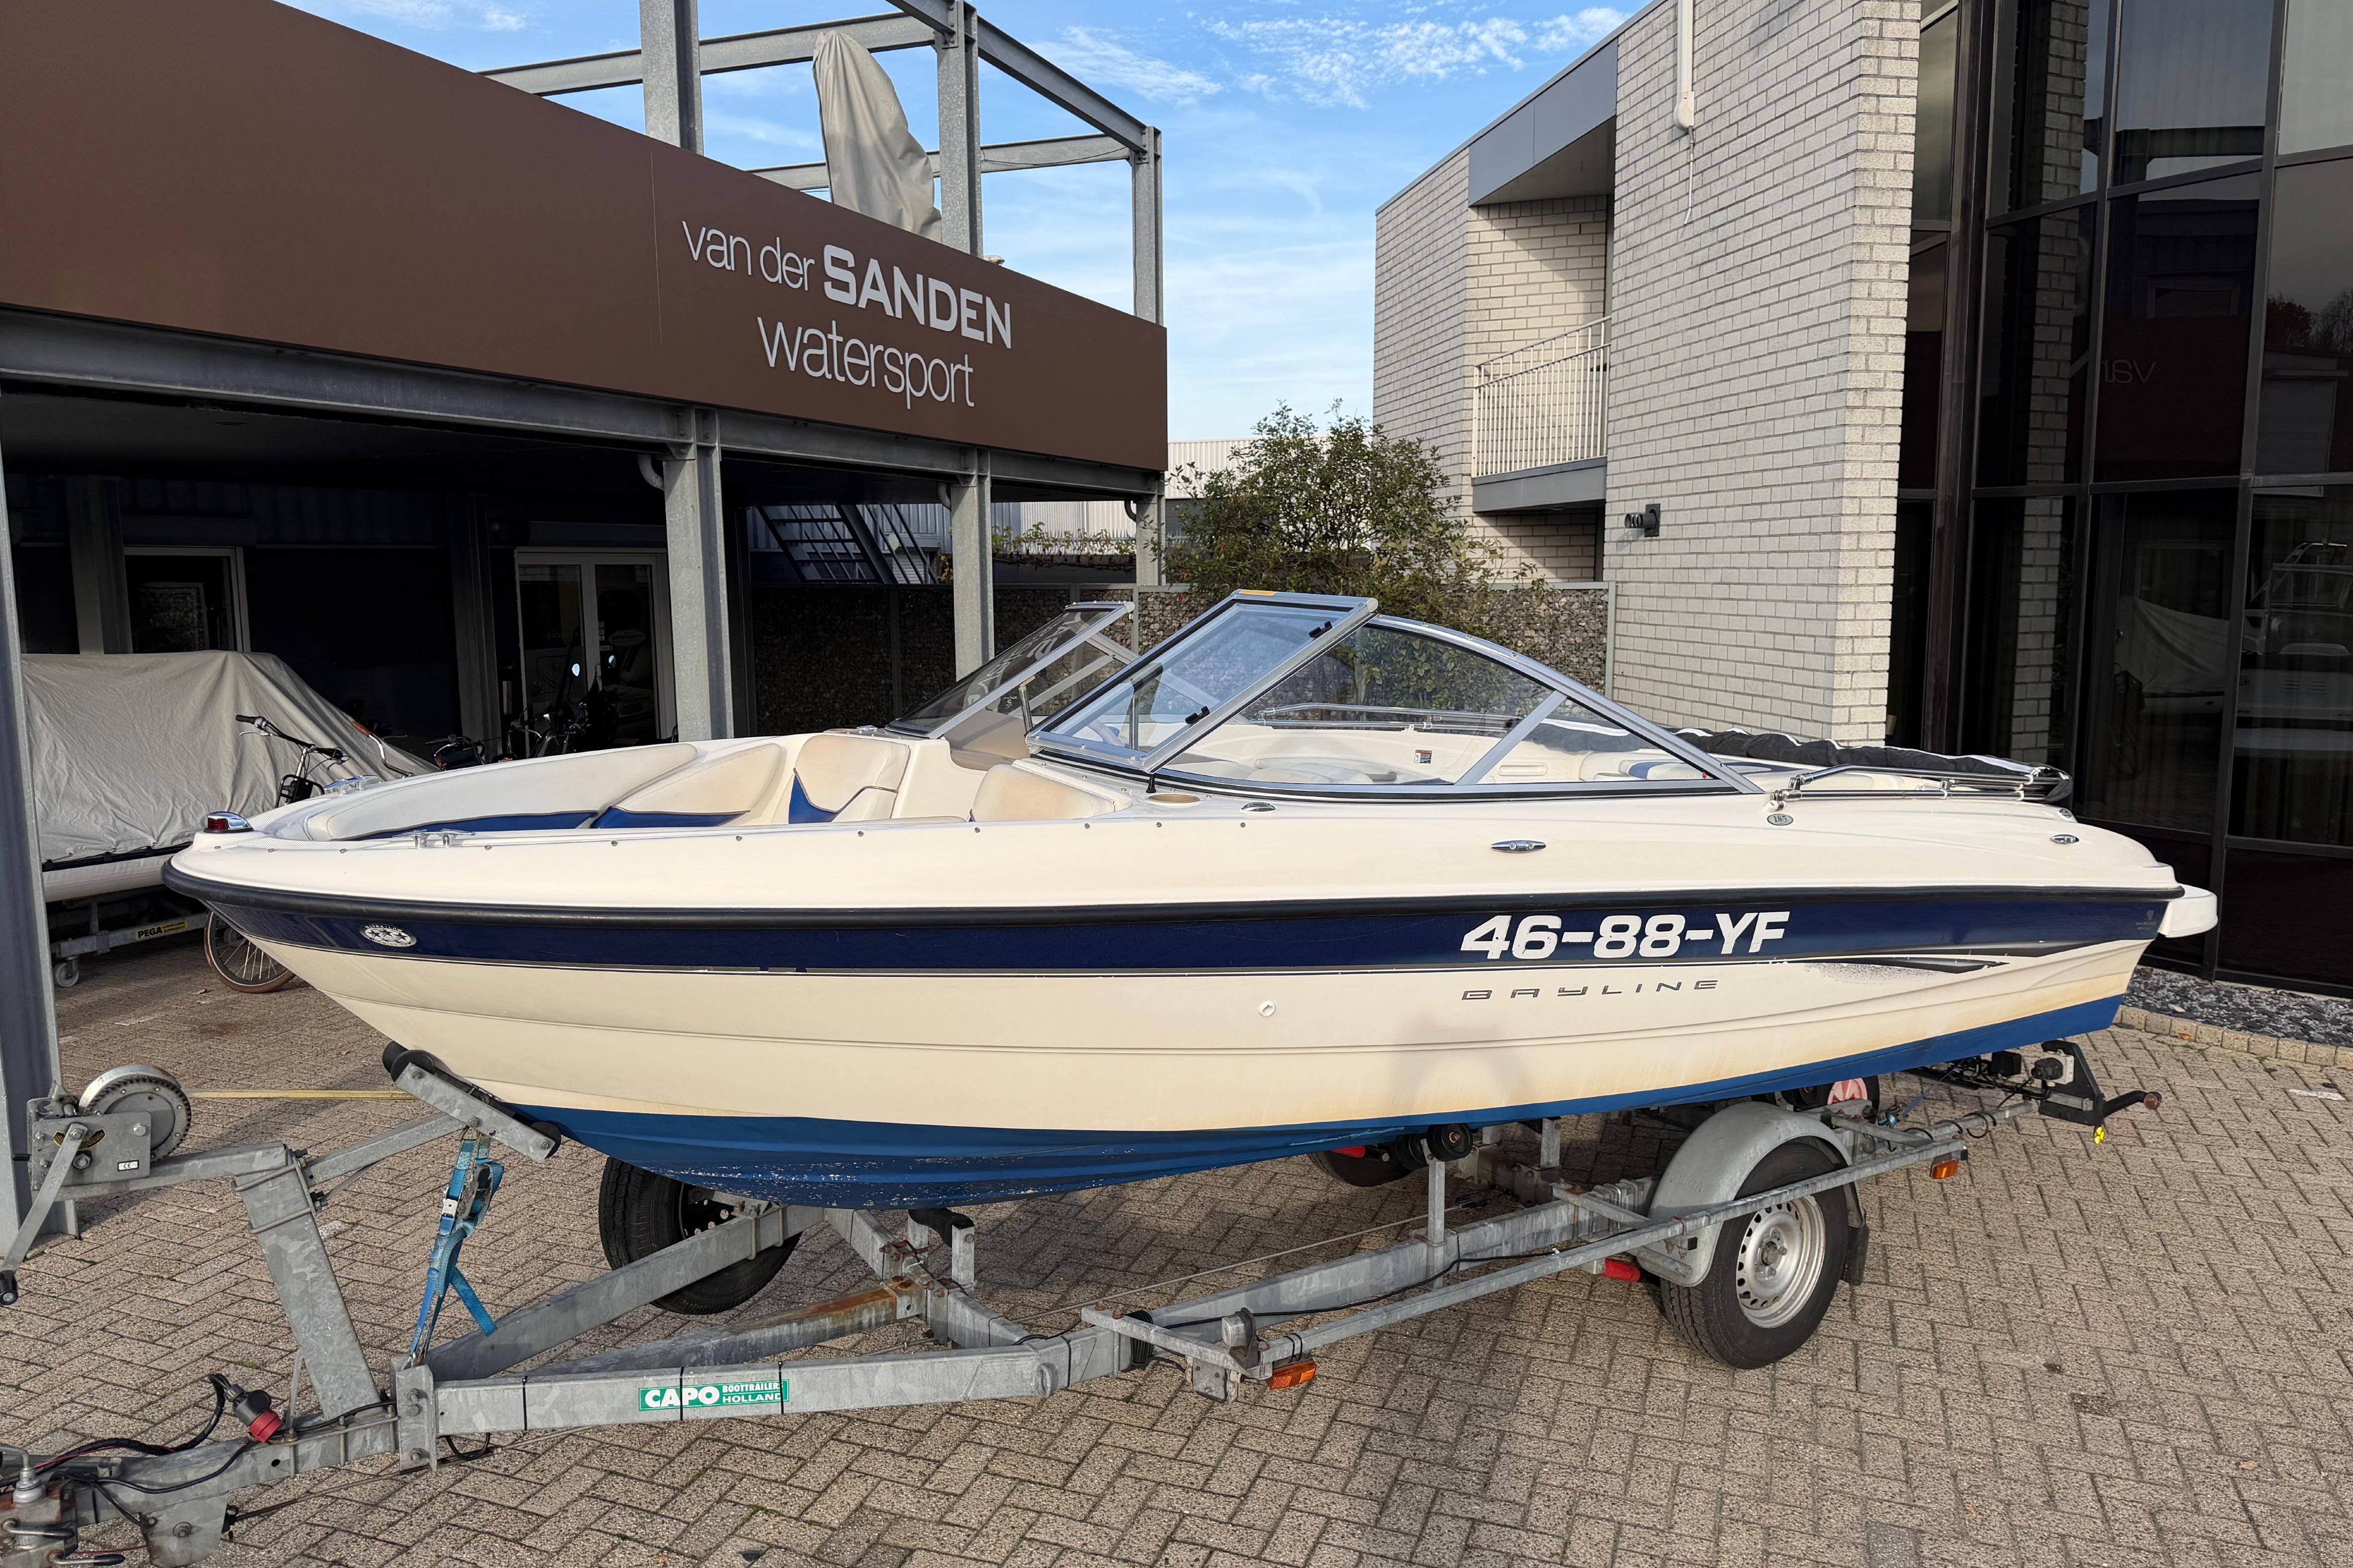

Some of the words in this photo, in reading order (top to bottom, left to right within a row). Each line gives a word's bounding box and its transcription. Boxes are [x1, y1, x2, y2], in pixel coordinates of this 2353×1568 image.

[682, 220, 752, 275] van
[759, 237, 815, 291] der
[823, 244, 1012, 349] SANDEN
[138, 927, 163, 939] PEGA
[1460, 911, 1790, 960] 46-88-YF
[1461, 980, 1718, 1000] BAYLINE
[644, 1386, 720, 1408] CAPO
